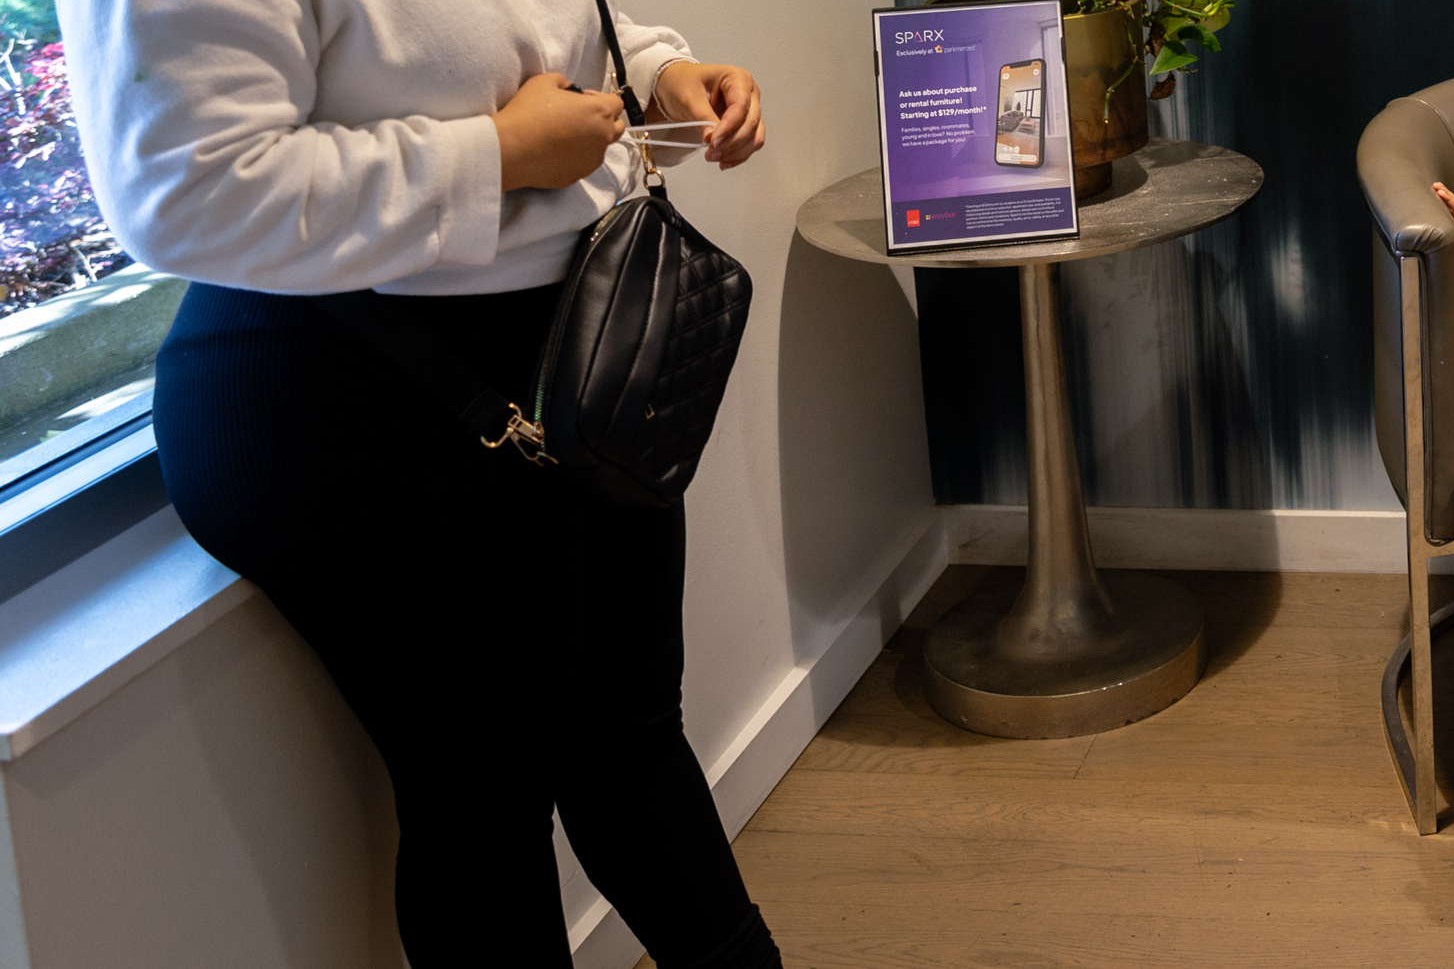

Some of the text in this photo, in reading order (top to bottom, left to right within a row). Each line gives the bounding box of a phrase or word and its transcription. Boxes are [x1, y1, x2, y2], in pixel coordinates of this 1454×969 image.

[896, 48, 927, 56] Exclusively
[922, 88, 943, 96] about
[944, 86, 977, 95] purchase
[930, 97, 962, 106] furniture!
[900, 111, 929, 119] Starting
[931, 211, 956, 220] wayfair
